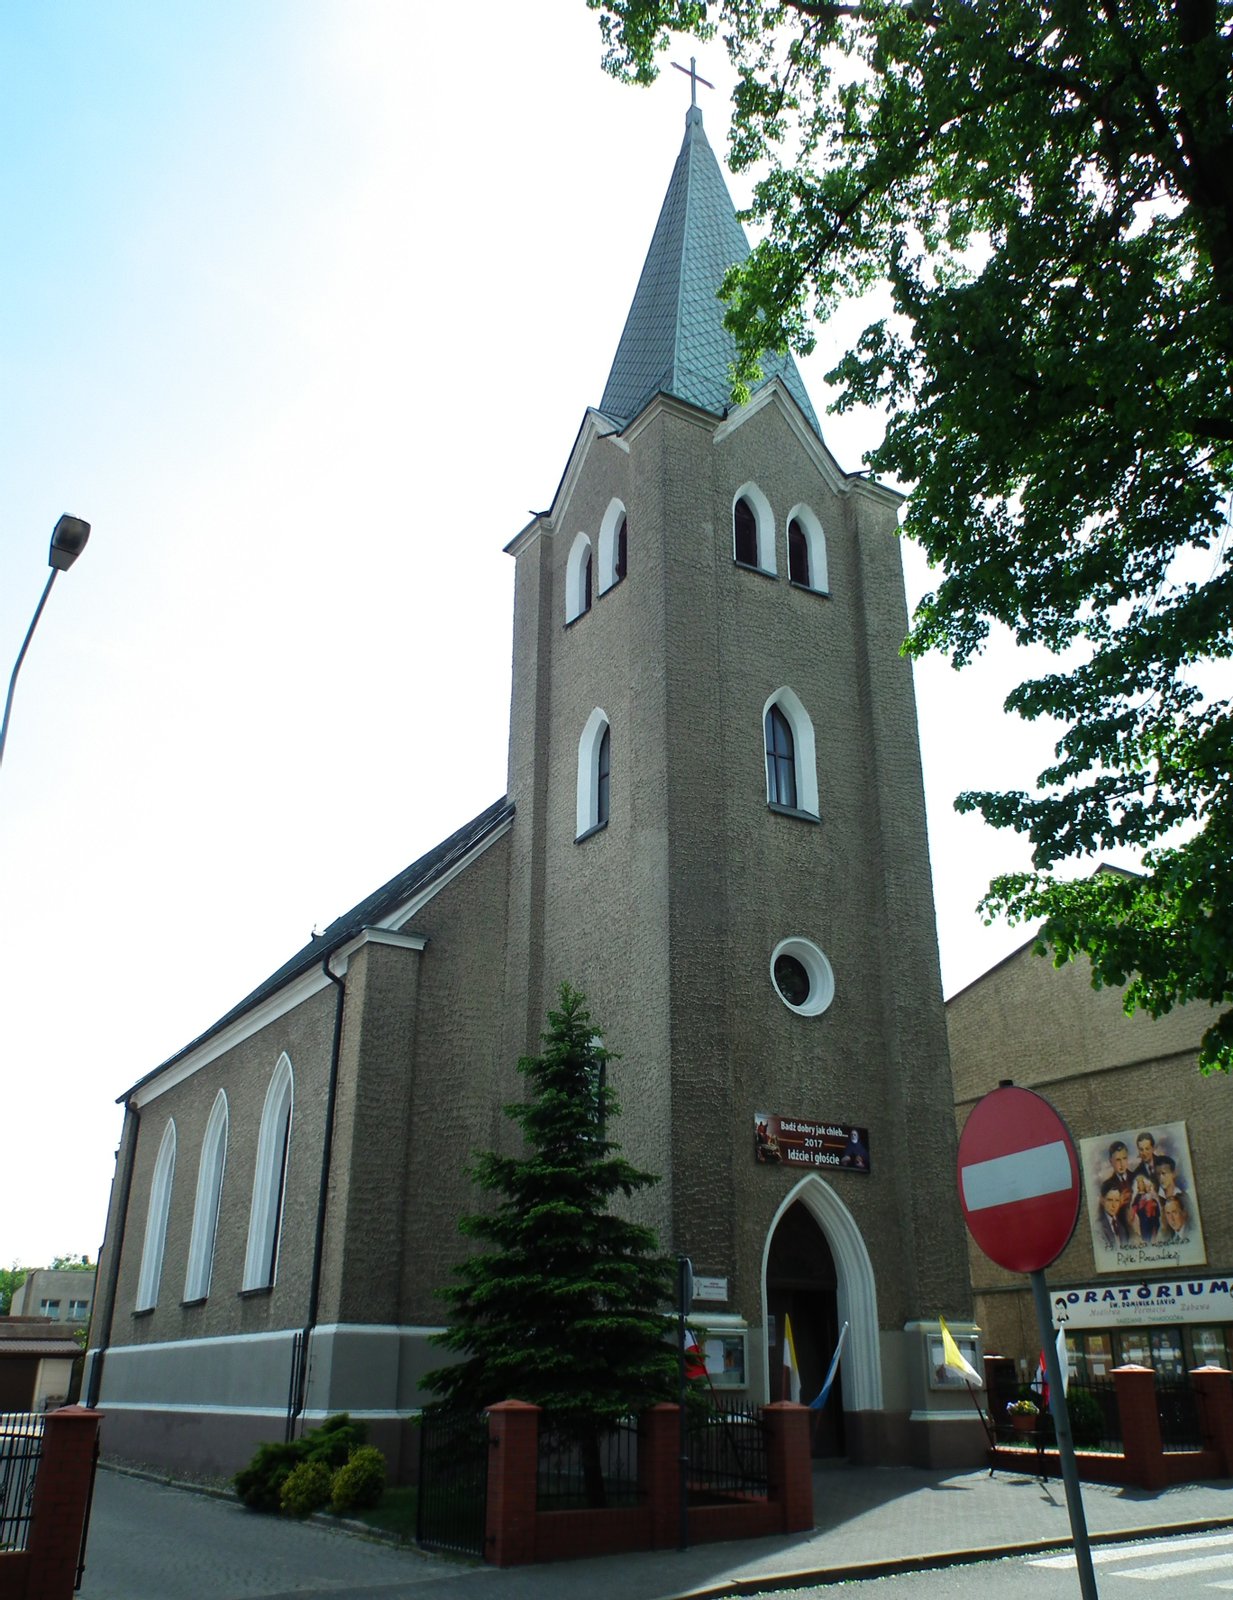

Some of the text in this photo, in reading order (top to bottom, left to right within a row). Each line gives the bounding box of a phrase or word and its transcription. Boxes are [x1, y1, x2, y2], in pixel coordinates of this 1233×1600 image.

[797, 1124, 815, 1135] dobry
[815, 1125, 826, 1136] jak
[804, 1138, 823, 1148] 2017
[810, 1151, 814, 1162] i
[815, 1153, 840, 1165] głoście
[1121, 1299, 1155, 1308] DOMINIKA
